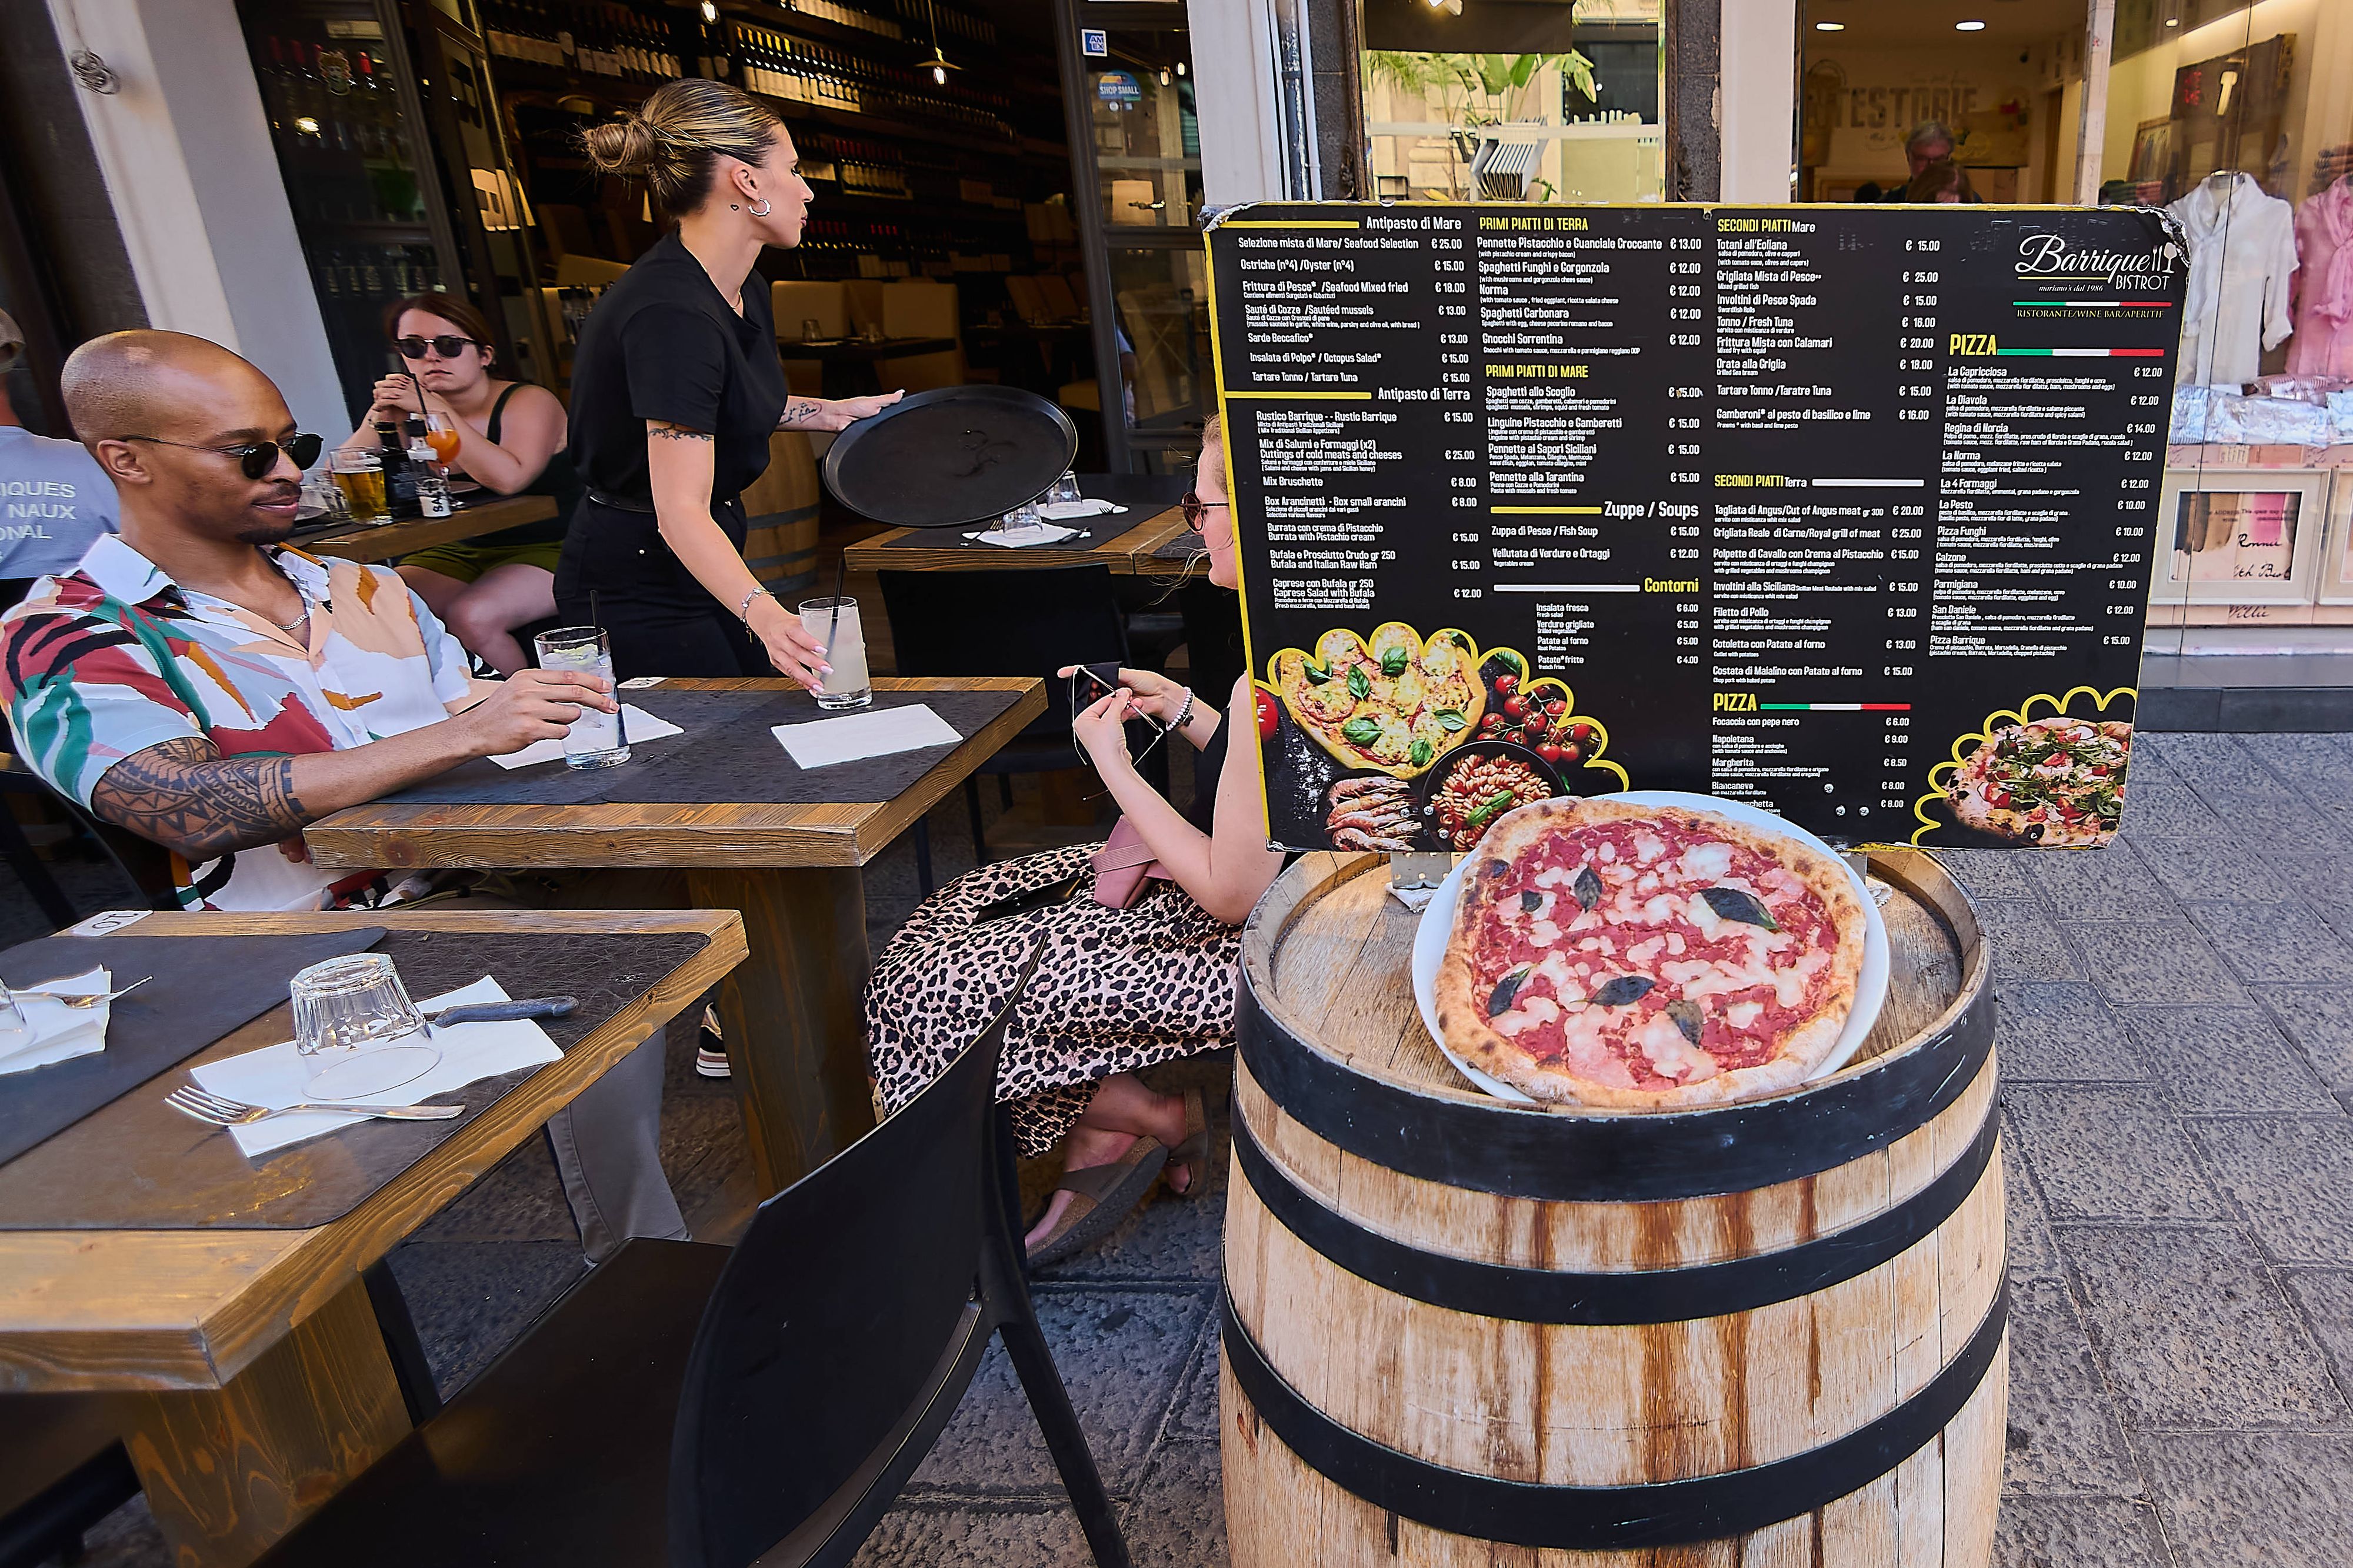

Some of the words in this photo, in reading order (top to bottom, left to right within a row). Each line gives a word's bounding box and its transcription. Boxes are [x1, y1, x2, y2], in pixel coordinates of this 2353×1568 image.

[1099, 86, 1117, 95] SHOP
[1118, 86, 1139, 95] SMALL
[1367, 216, 1418, 232] Antipasto
[1420, 216, 1431, 229] di
[1433, 216, 1462, 230] Mare
[1479, 217, 1509, 230] PRIMI
[1511, 217, 1541, 231] PIATTI
[1544, 217, 1554, 231] DI
[1556, 218, 1588, 231] TERRA
[1718, 218, 1759, 232] SECONDI
[1761, 219, 1791, 232] PIATTI
[1792, 222, 1816, 232] Mare
[1238, 237, 1278, 248] Selezione
[1279, 237, 1305, 248] mista
[1306, 237, 1315, 248] di
[1315, 237, 1342, 249] Mare/
[1344, 237, 1379, 249] Seafood
[1380, 238, 1419, 249] Selection
[1431, 238, 1438, 249] €
[1439, 238, 1462, 249] 25.00
[1717, 238, 1742, 250] Totani
[1744, 239, 1788, 251] all'Eoliana
[1905, 239, 1912, 251] €
[1917, 240, 1940, 251] 15.00
[1492, 250, 1515, 259] pistachio
[1542, 251, 1558, 259] crispy
[1558, 251, 1576, 259] bacon)
[2015, 234, 2151, 284] Barrique
[2115, 275, 2170, 291] BISTROT
[1717, 293, 1751, 305] Involtini
[1752, 294, 1761, 305] di
[1762, 293, 1788, 305] Pesce
[1789, 294, 1817, 308] Spada
[1903, 295, 1910, 306] €
[1915, 295, 1937, 306] 15.00
[1245, 304, 1268, 315] Sauté
[1269, 304, 1277, 314] di
[1277, 305, 1301, 315] Cozze
[1304, 305, 1340, 316] /Sautéed
[1341, 305, 1374, 315] mussels
[1438, 305, 1444, 315] €
[1445, 305, 1466, 316] 13.00
[1480, 306, 1522, 321] Spaghetti
[1524, 307, 1569, 319] Carbonara
[1670, 308, 1677, 319] €
[1678, 308, 1701, 319] 12.00
[1717, 336, 1751, 348] Frittura
[1751, 336, 1776, 348] Mista
[1777, 339, 1793, 348] con
[1794, 336, 1832, 348] Calamari
[1900, 337, 1907, 348] €
[1909, 338, 1934, 349] 20.00
[1949, 333, 1997, 356] PIZZA
[1485, 364, 1514, 378] PRIMI
[1517, 365, 1545, 378] PIATTI
[1548, 365, 1558, 378] DI
[1560, 365, 1589, 378] MARE
[1948, 366, 1959, 377] La
[1959, 366, 2008, 378] Capricciosa
[2134, 367, 2141, 377] €
[2142, 367, 2162, 377] 12.00
[1378, 387, 1428, 403] Antipasto
[1430, 388, 1440, 401] di
[1442, 388, 1471, 401] Terra
[1259, 449, 1295, 461] Cuttings
[1295, 449, 1305, 459] of
[1305, 449, 1324, 459] cold
[1324, 449, 1351, 461] meats
[1351, 449, 1368, 461] and
[1368, 449, 1402, 460] cheeses
[1445, 449, 1452, 460] €
[1452, 450, 1475, 460] 25.00
[1262, 476, 1278, 486] Mix
[1278, 476, 1324, 486] Bruschette
[1451, 477, 1458, 487] €
[1458, 477, 1477, 488] 8.00
[1714, 475, 1754, 487] SECONDI
[1755, 475, 1784, 487] PIATTI
[1784, 476, 1807, 488] Terra
[1940, 478, 1951, 488] La
[1951, 478, 1958, 488] 4
[1959, 478, 1998, 490] Formaggi
[2121, 479, 2128, 489] €
[2129, 479, 2149, 489] 12.00
[0, 481, 76, 498] IQUES
[8, 503, 77, 520] NAUX
[1604, 501, 1645, 520] Zuppe
[1647, 501, 1655, 518] /
[1658, 501, 1699, 521] Soups
[1491, 525, 1517, 538] Zuppa
[1518, 525, 1526, 536] di
[1527, 525, 1552, 536] Pesce
[1553, 525, 1558, 536] /
[1559, 525, 1577, 536] Fish
[1577, 525, 1598, 538] Soup
[1670, 526, 1677, 536] €
[1678, 526, 1699, 537] 15.00
[1935, 552, 1967, 562] Calzone
[2113, 553, 2119, 562] €
[2121, 553, 2141, 562] 12.00
[1644, 577, 1699, 592] Contorni
[1934, 579, 1978, 590] Parmigiana
[2109, 579, 2115, 589] €
[2117, 580, 2137, 589] 10.00
[1713, 607, 1739, 617] Filetto
[1740, 607, 1749, 617] di
[1749, 607, 1769, 617] Pollo
[1887, 608, 1894, 618] €
[1895, 608, 1917, 618] 13.00
[1932, 605, 1947, 615] San
[1948, 605, 1977, 615] Daniele
[2107, 605, 2113, 615] €
[2114, 605, 2134, 615] 12.00
[1537, 620, 1565, 629] Verdure
[1565, 620, 1595, 630] grigliate
[1677, 620, 1682, 629] €
[1683, 620, 1699, 629] 5.00
[1929, 635, 1951, 645] Pizza
[1952, 635, 1988, 648] Barrique
[2103, 636, 2109, 645] €
[2111, 636, 2130, 645] 15.00
[1714, 693, 1757, 712] PIZZA
[1712, 717, 1746, 726] Focaccia
[1762, 719, 1781, 728] pepe
[1885, 717, 1892, 726] €
[1892, 717, 1909, 726] 6.00
[1712, 758, 1754, 768] Margherita
[1884, 758, 1889, 767] €
[1890, 758, 1907, 767] 8.50
